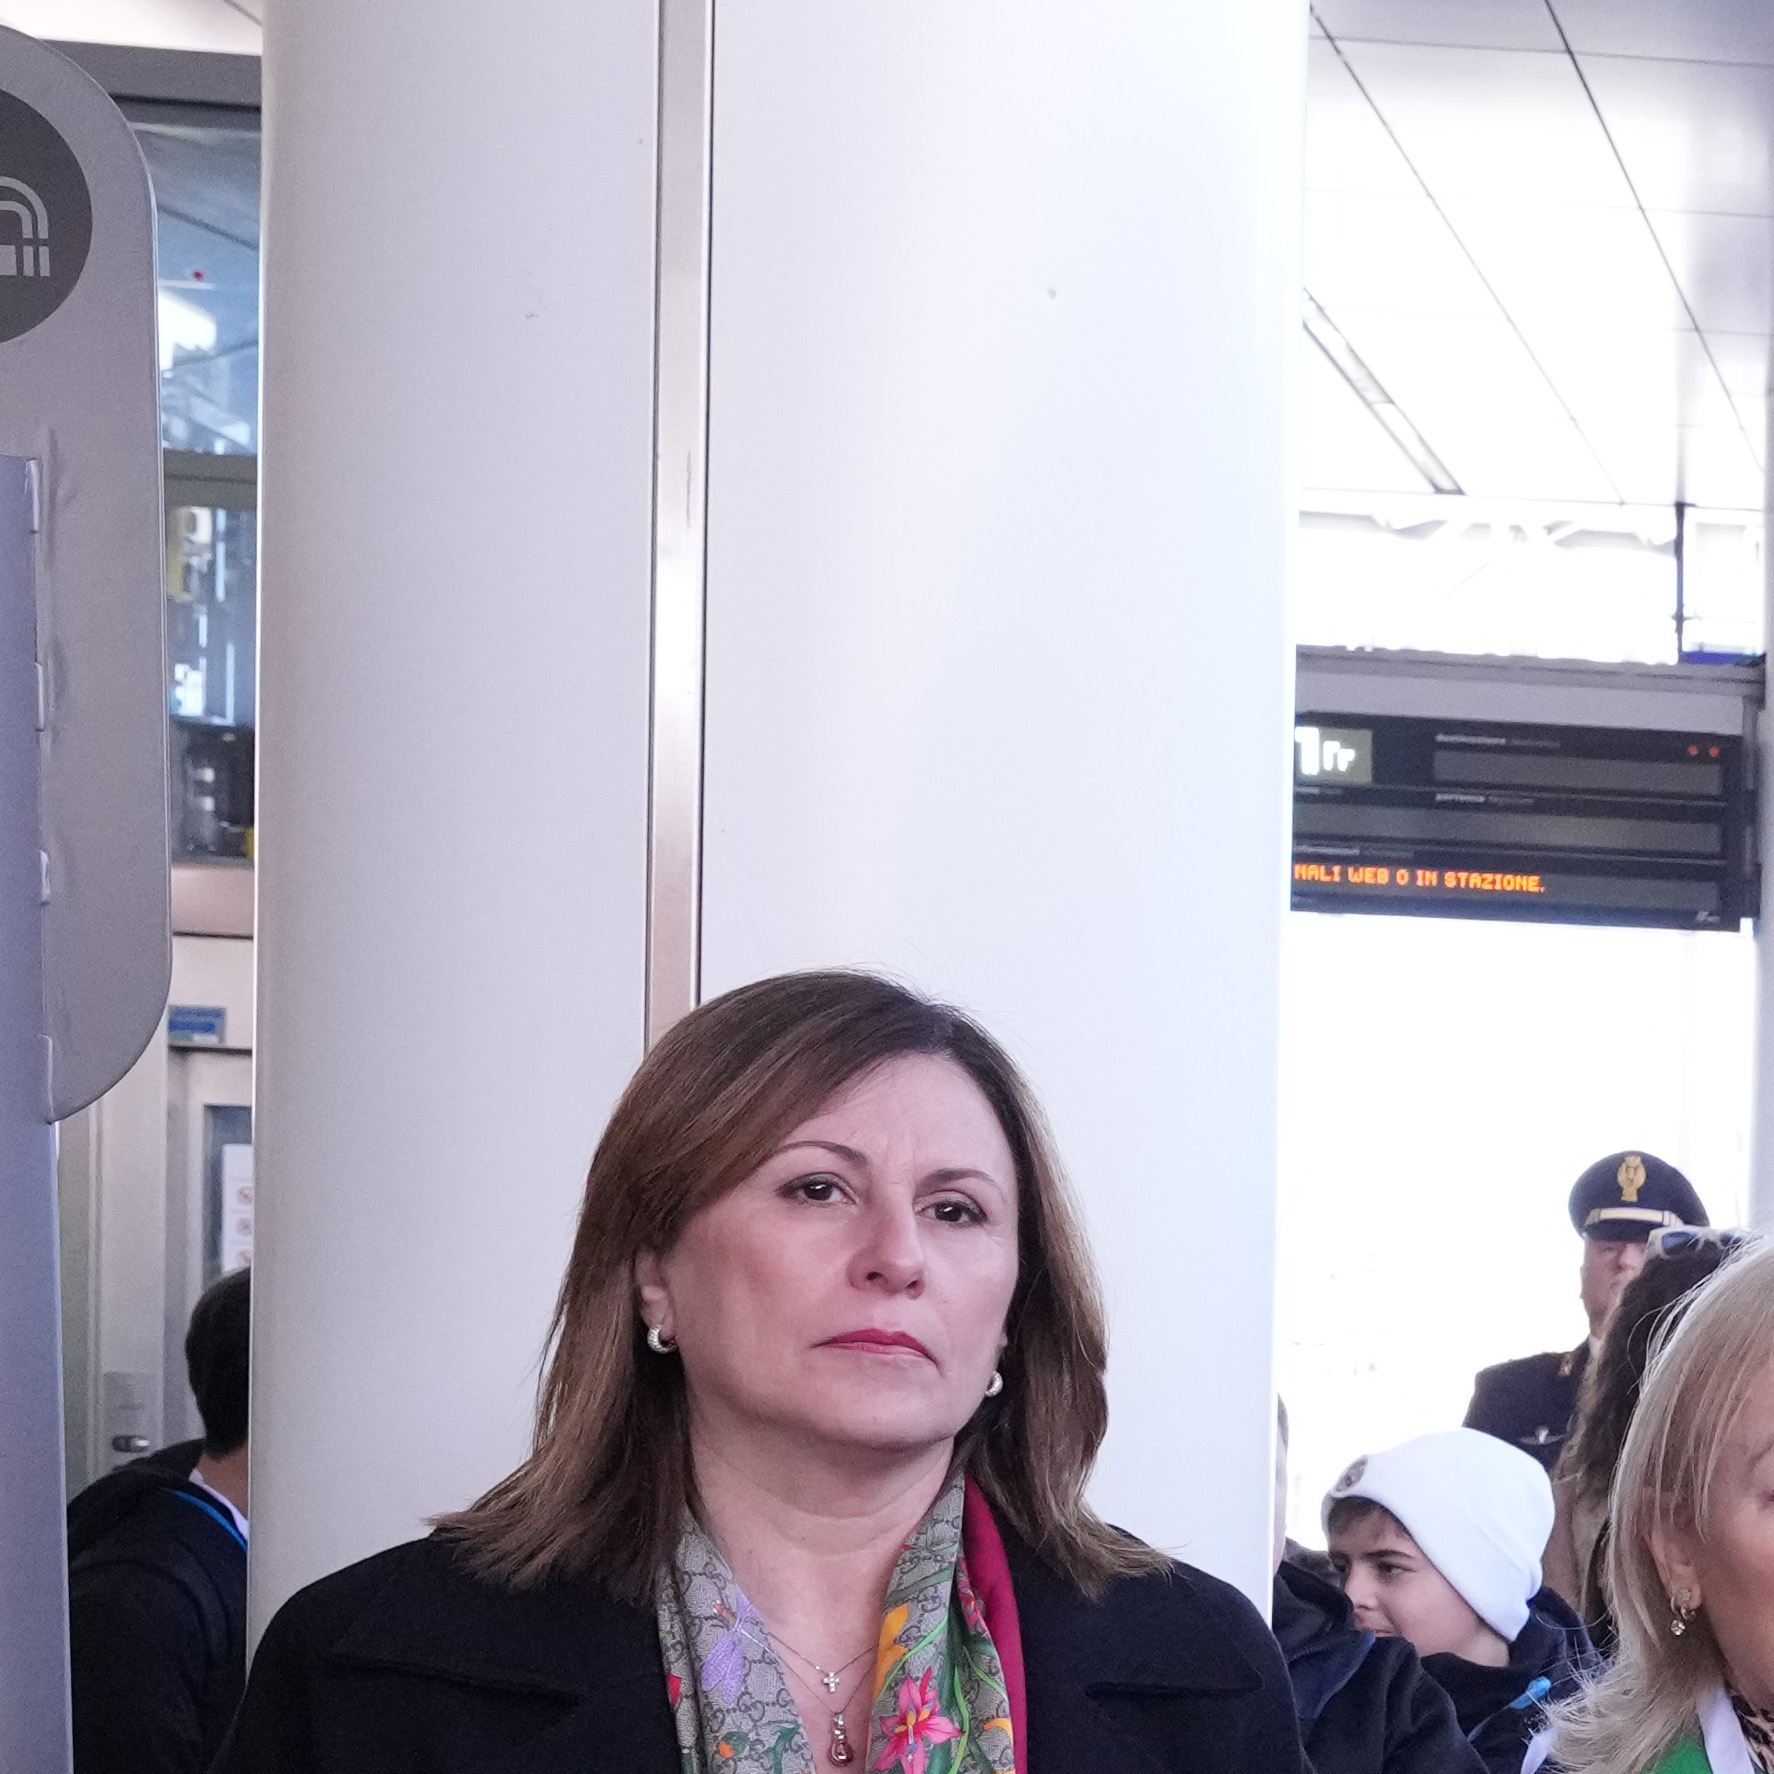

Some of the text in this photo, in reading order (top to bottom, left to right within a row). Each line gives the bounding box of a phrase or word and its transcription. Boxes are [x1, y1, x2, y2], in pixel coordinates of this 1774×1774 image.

[1347, 866, 1390, 885] WEB
[1415, 869, 1438, 888] IN
[1444, 871, 1546, 893] STAZIONE.
